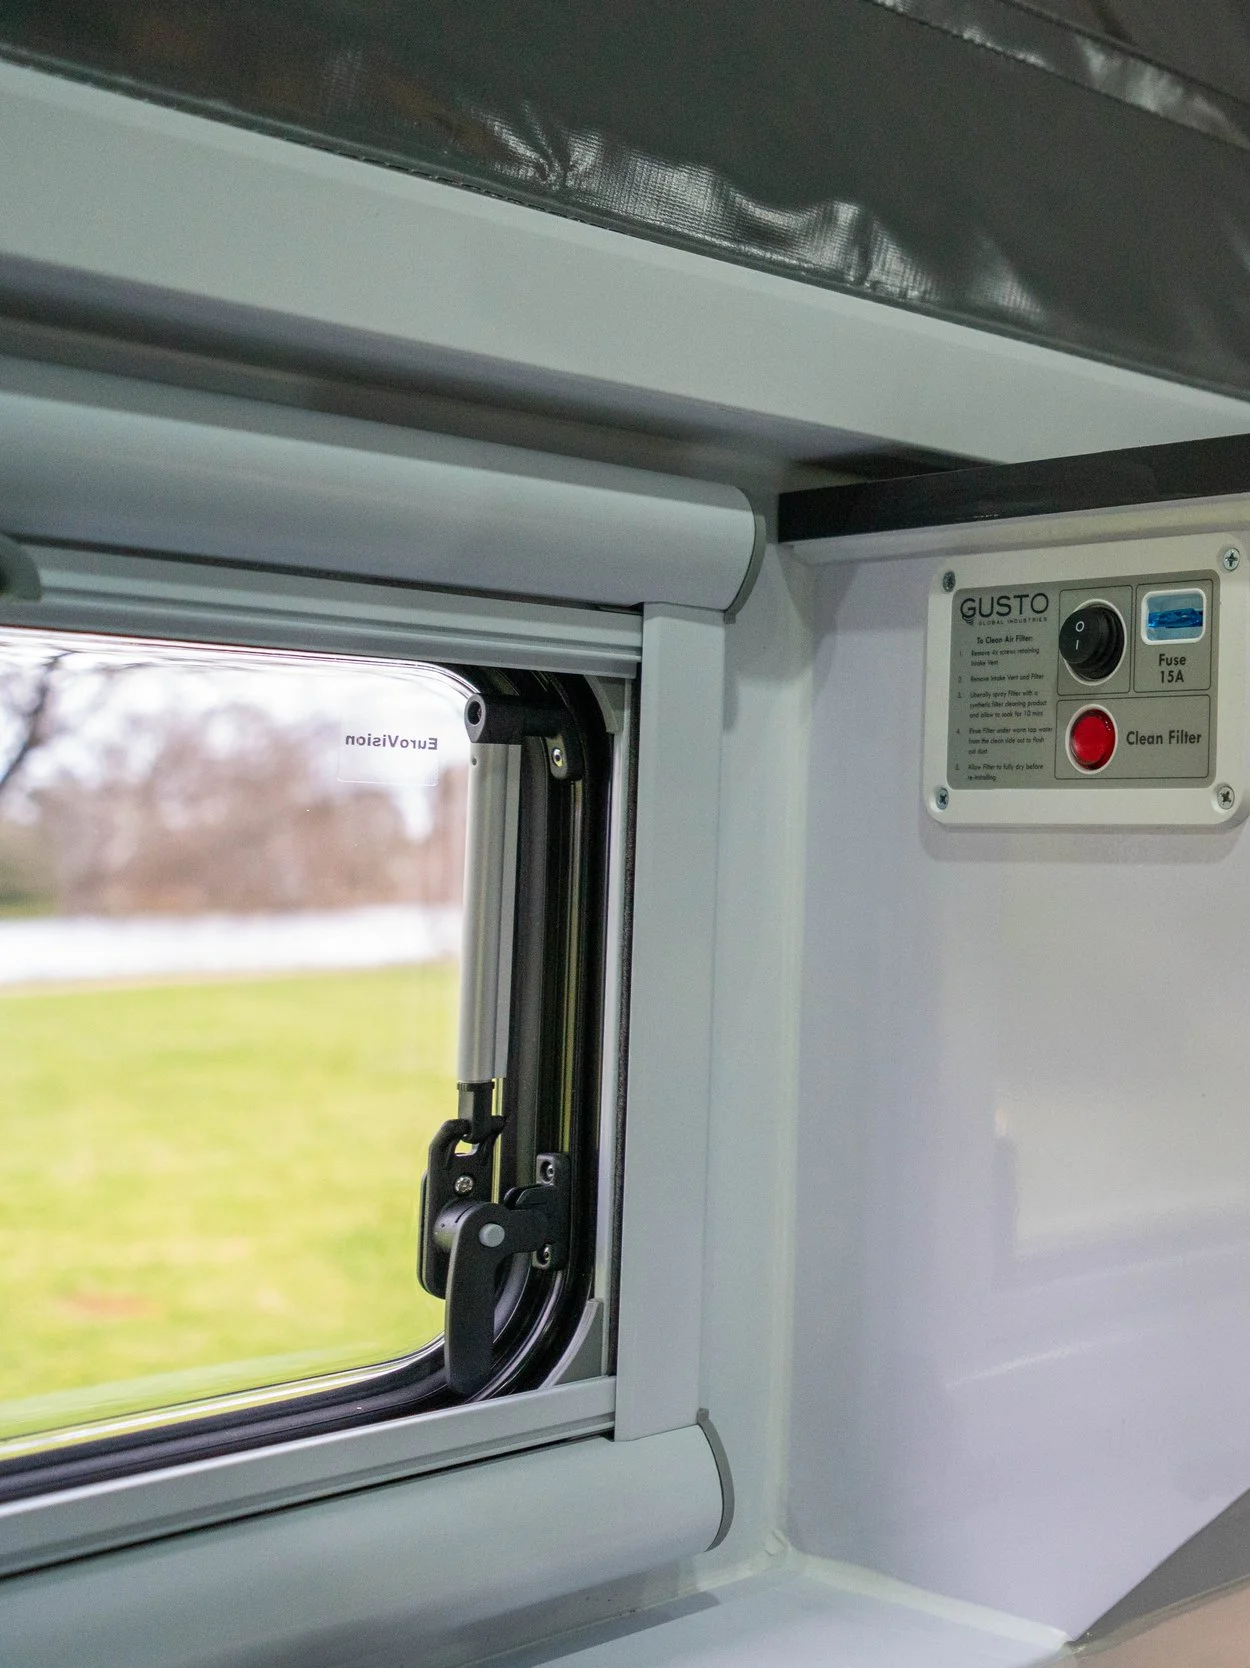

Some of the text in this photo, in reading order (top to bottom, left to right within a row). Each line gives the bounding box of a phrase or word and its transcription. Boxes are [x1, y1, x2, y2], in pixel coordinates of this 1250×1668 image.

[960, 593, 1049, 618] GUSTO
[1159, 653, 1187, 666] Fuse
[1160, 670, 1185, 683] 15A
[1126, 729, 1202, 745] Clean Filter
